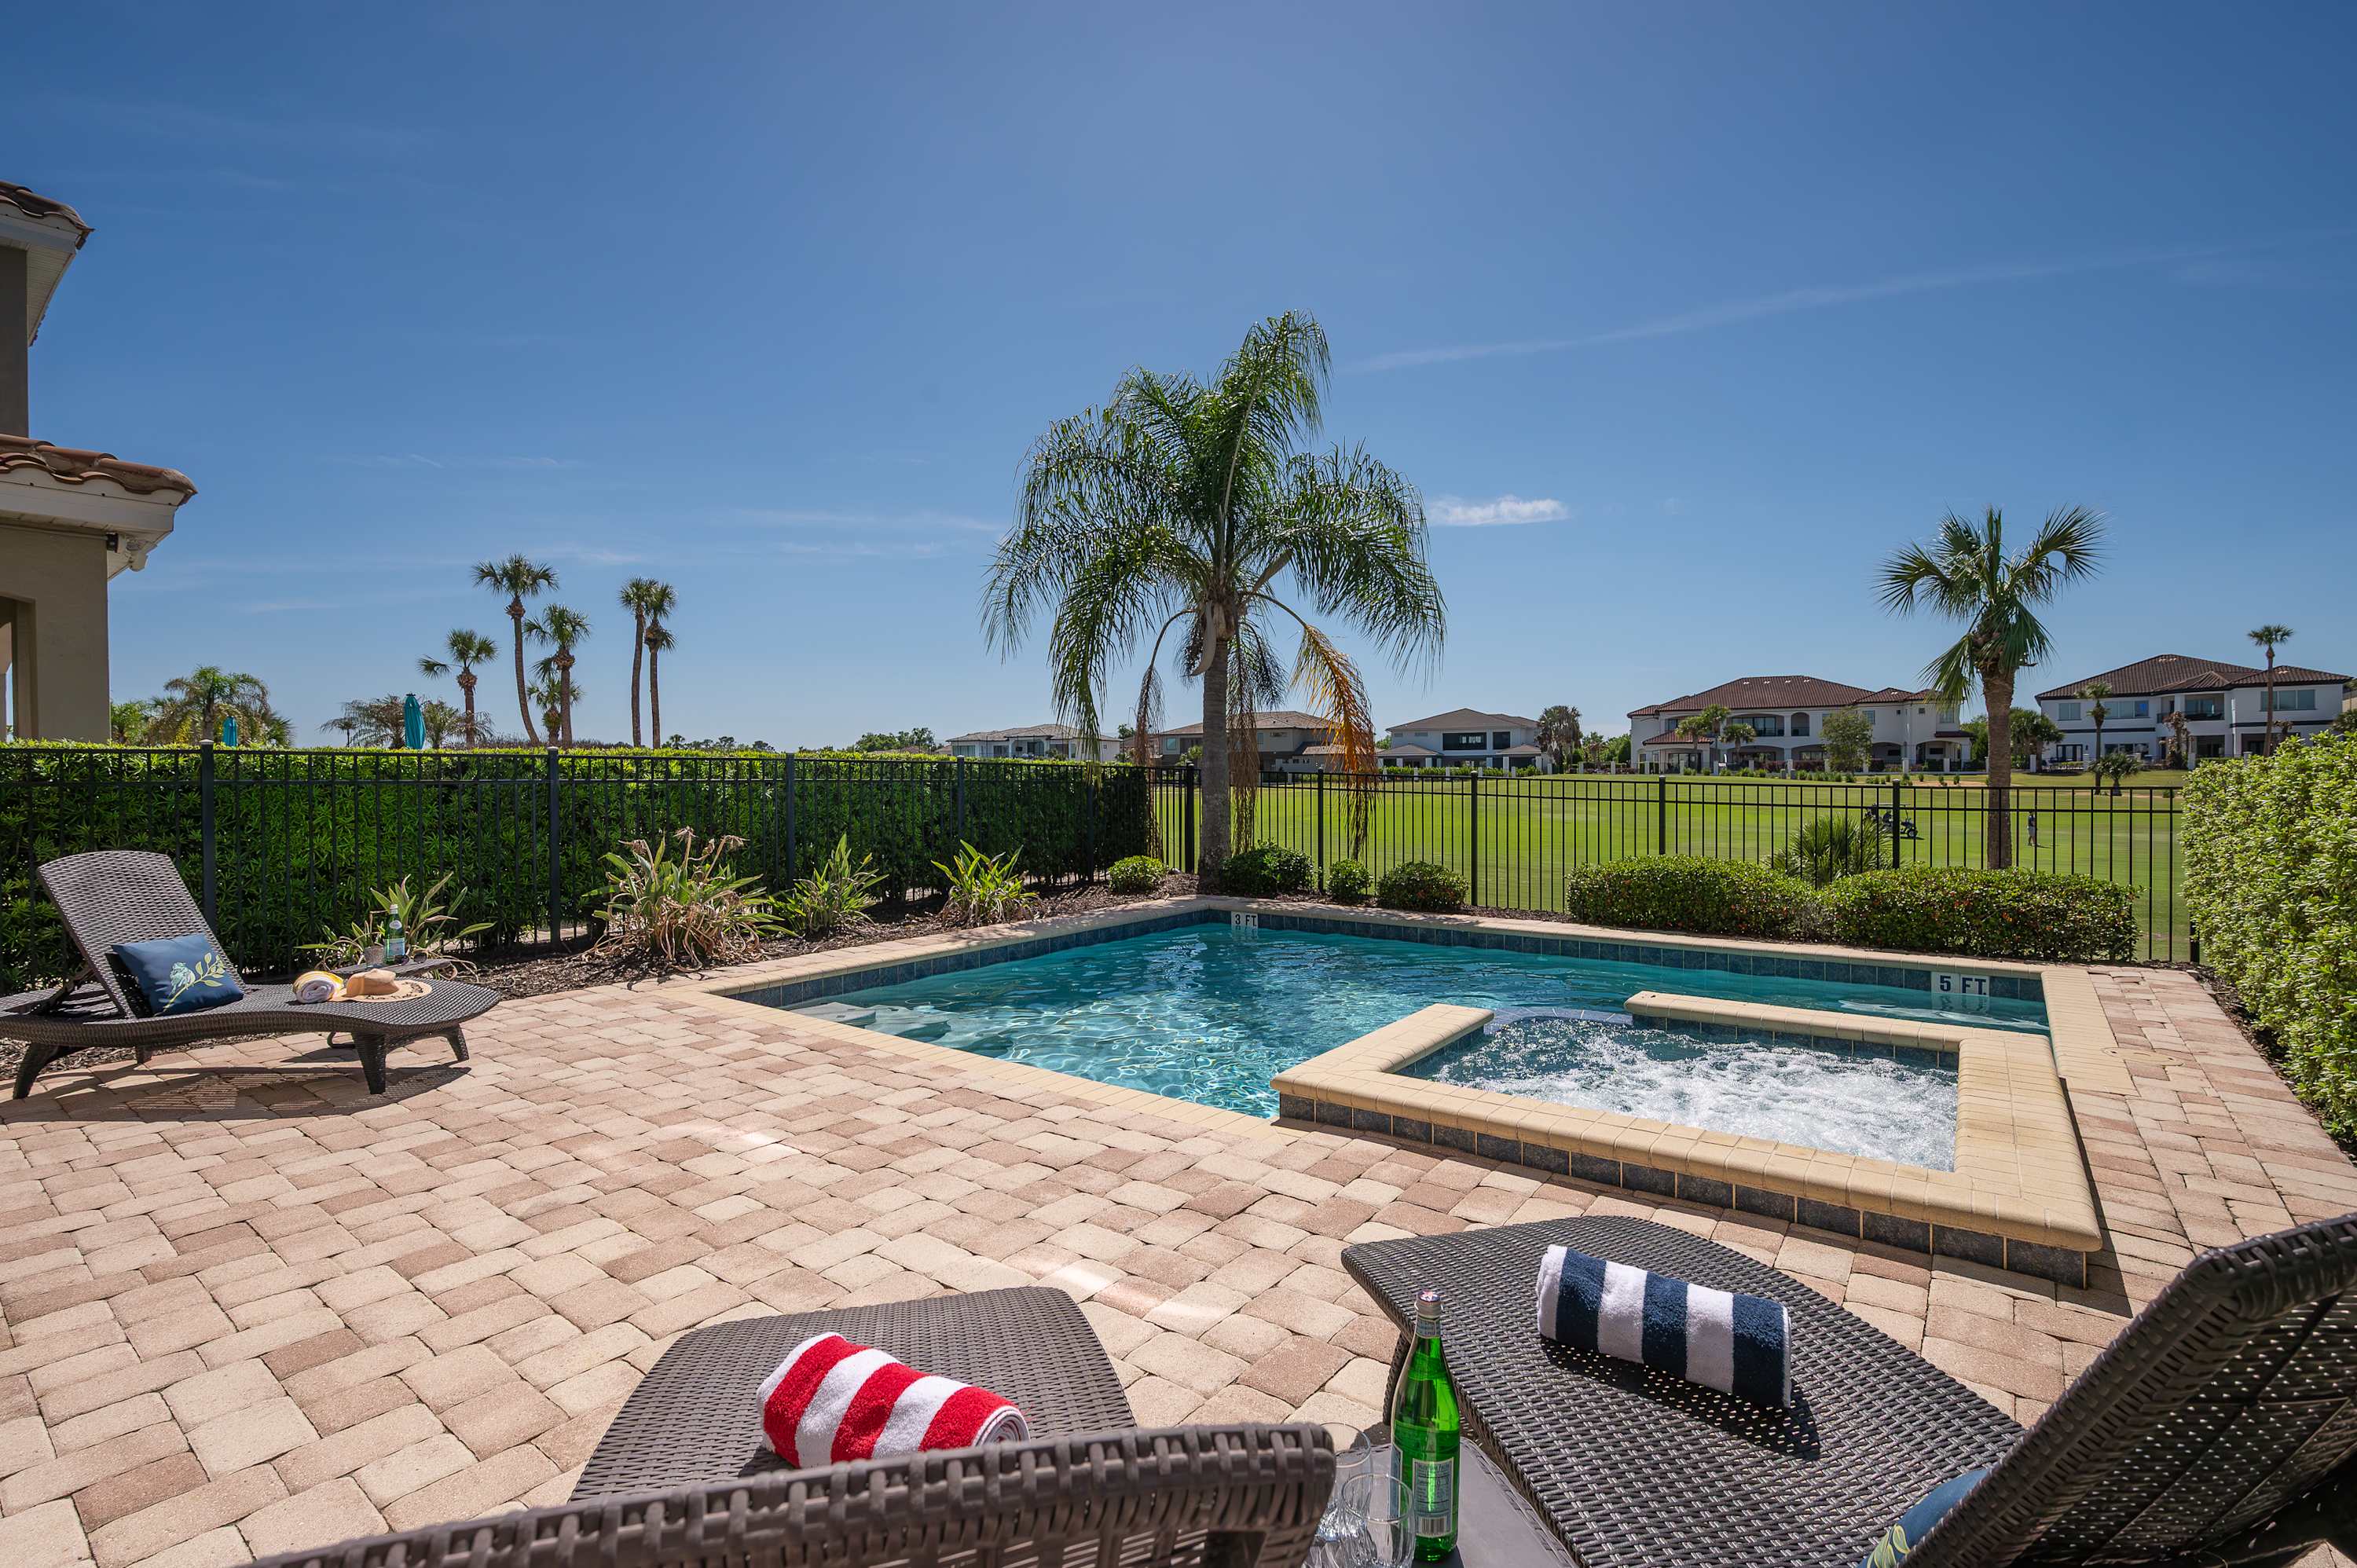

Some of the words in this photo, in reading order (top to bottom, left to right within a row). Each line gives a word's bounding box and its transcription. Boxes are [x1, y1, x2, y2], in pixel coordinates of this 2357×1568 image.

[1235, 914, 1241, 925] 3
[1940, 975, 1951, 992] 5
[1961, 976, 1987, 995] FT.
